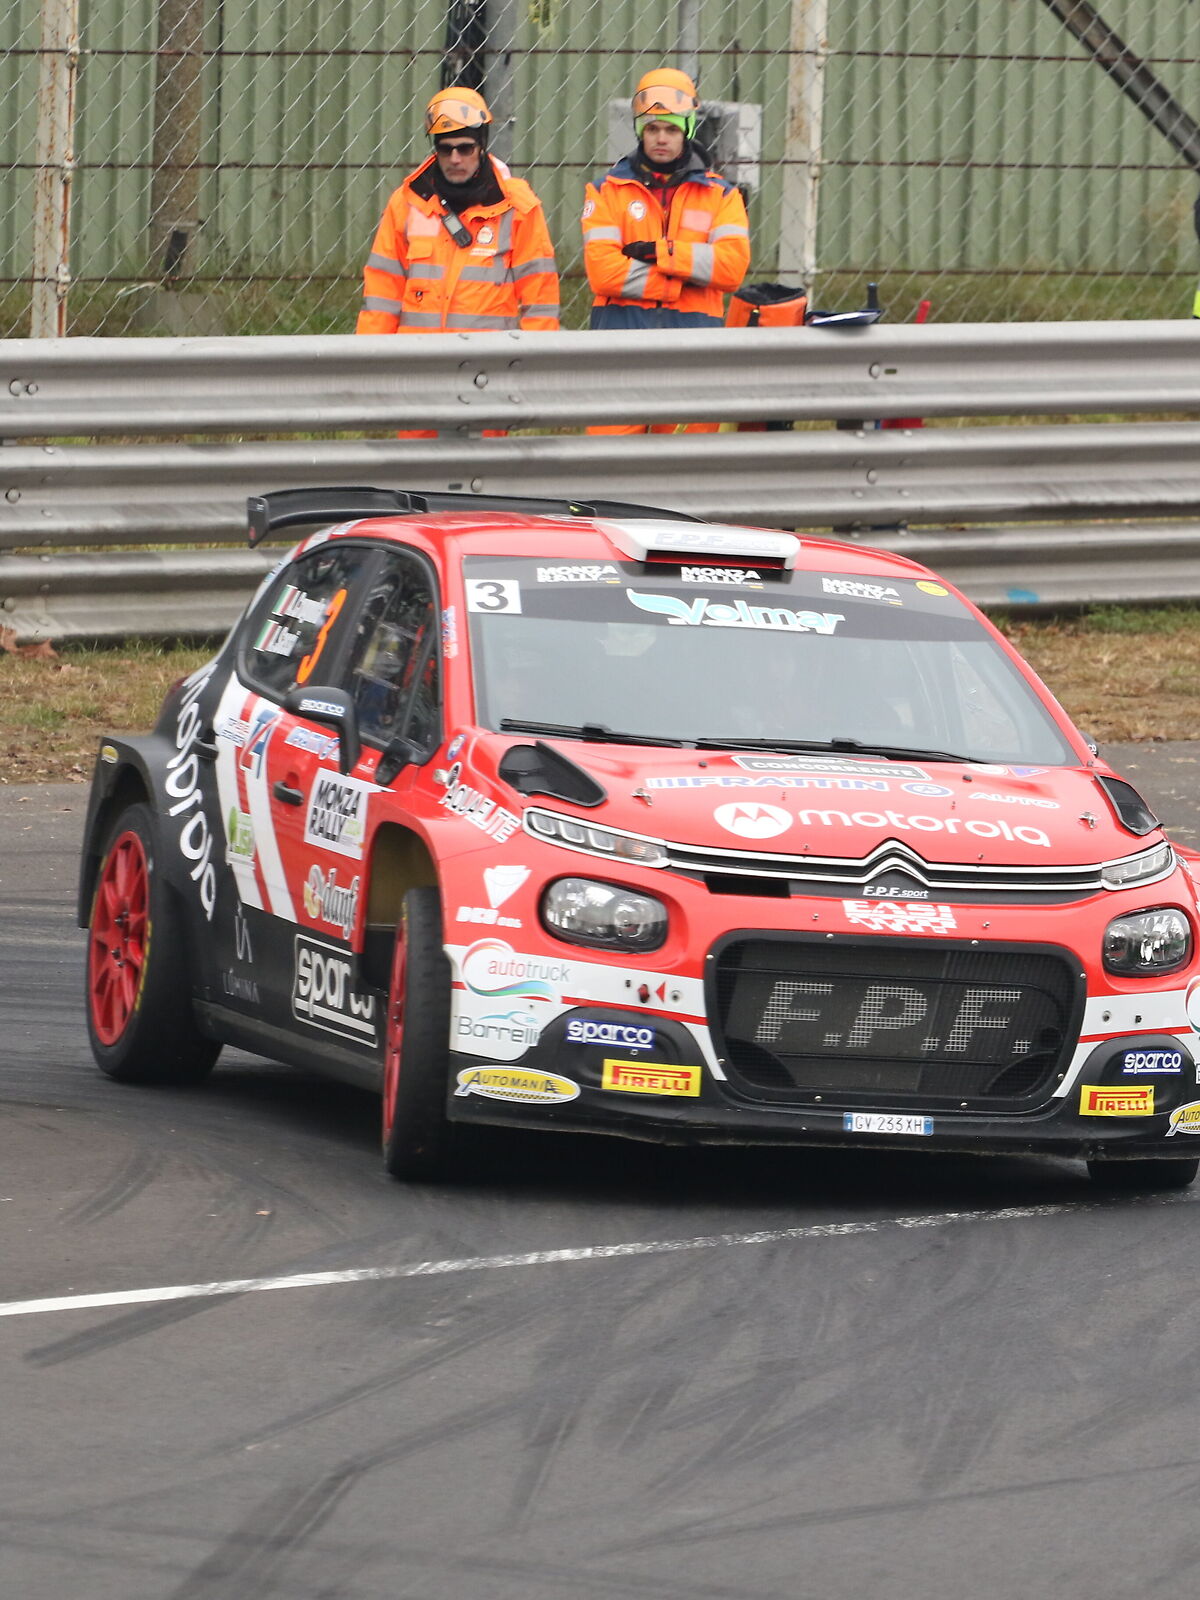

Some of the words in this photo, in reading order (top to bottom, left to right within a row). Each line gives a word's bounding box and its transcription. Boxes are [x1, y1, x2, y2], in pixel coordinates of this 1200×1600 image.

[536, 565, 619, 575] MONZA
[537, 573, 604, 583] RALLY
[681, 566, 761, 580] MONZA
[682, 573, 747, 585] RALLY
[475, 581, 509, 611] 3
[821, 577, 900, 597] MONZA
[822, 585, 884, 600] RALLY
[626, 588, 846, 635] Volmar
[296, 588, 348, 684] 3
[299, 699, 346, 714] sparco
[751, 761, 918, 777] CONCORRENTE
[313, 780, 361, 819] MONZA
[692, 776, 889, 792] FRATTIN
[969, 792, 1061, 810] AUTO
[308, 807, 348, 842] RALLY
[798, 809, 1052, 848] motorola
[487, 960, 572, 981] autotruck
[754, 981, 1032, 1053] F.P.F.
[567, 1020, 653, 1044] sparco
[1124, 1052, 1182, 1075] sparco
[462, 1071, 558, 1092] AUTOMANIA
[611, 1065, 692, 1091] PIRELLI
[1088, 1091, 1148, 1111] PIRELLI
[855, 1115, 872, 1130] GV
